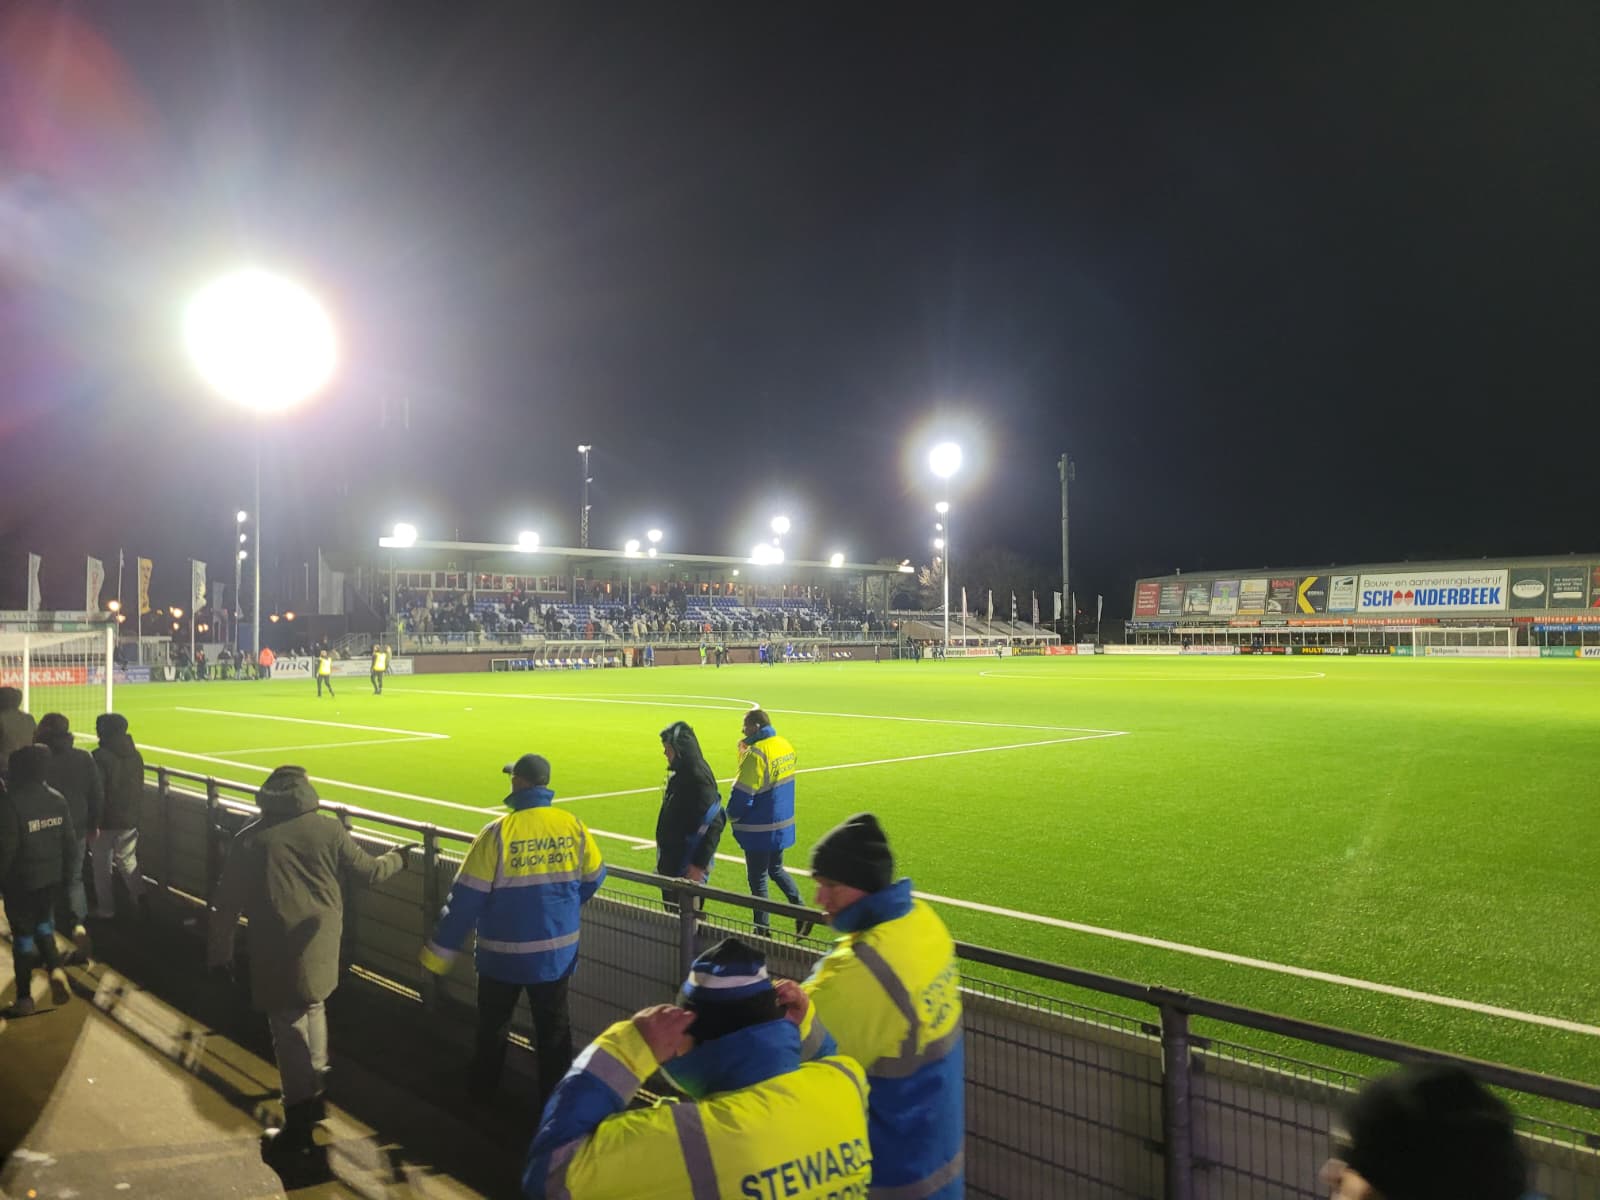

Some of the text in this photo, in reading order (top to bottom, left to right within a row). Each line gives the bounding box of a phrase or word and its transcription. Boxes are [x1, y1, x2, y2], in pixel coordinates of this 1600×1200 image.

[2, 671, 75, 683] JAKS.NL
[509, 836, 575, 854] STEWARD
[511, 854, 546, 868] QUICK
